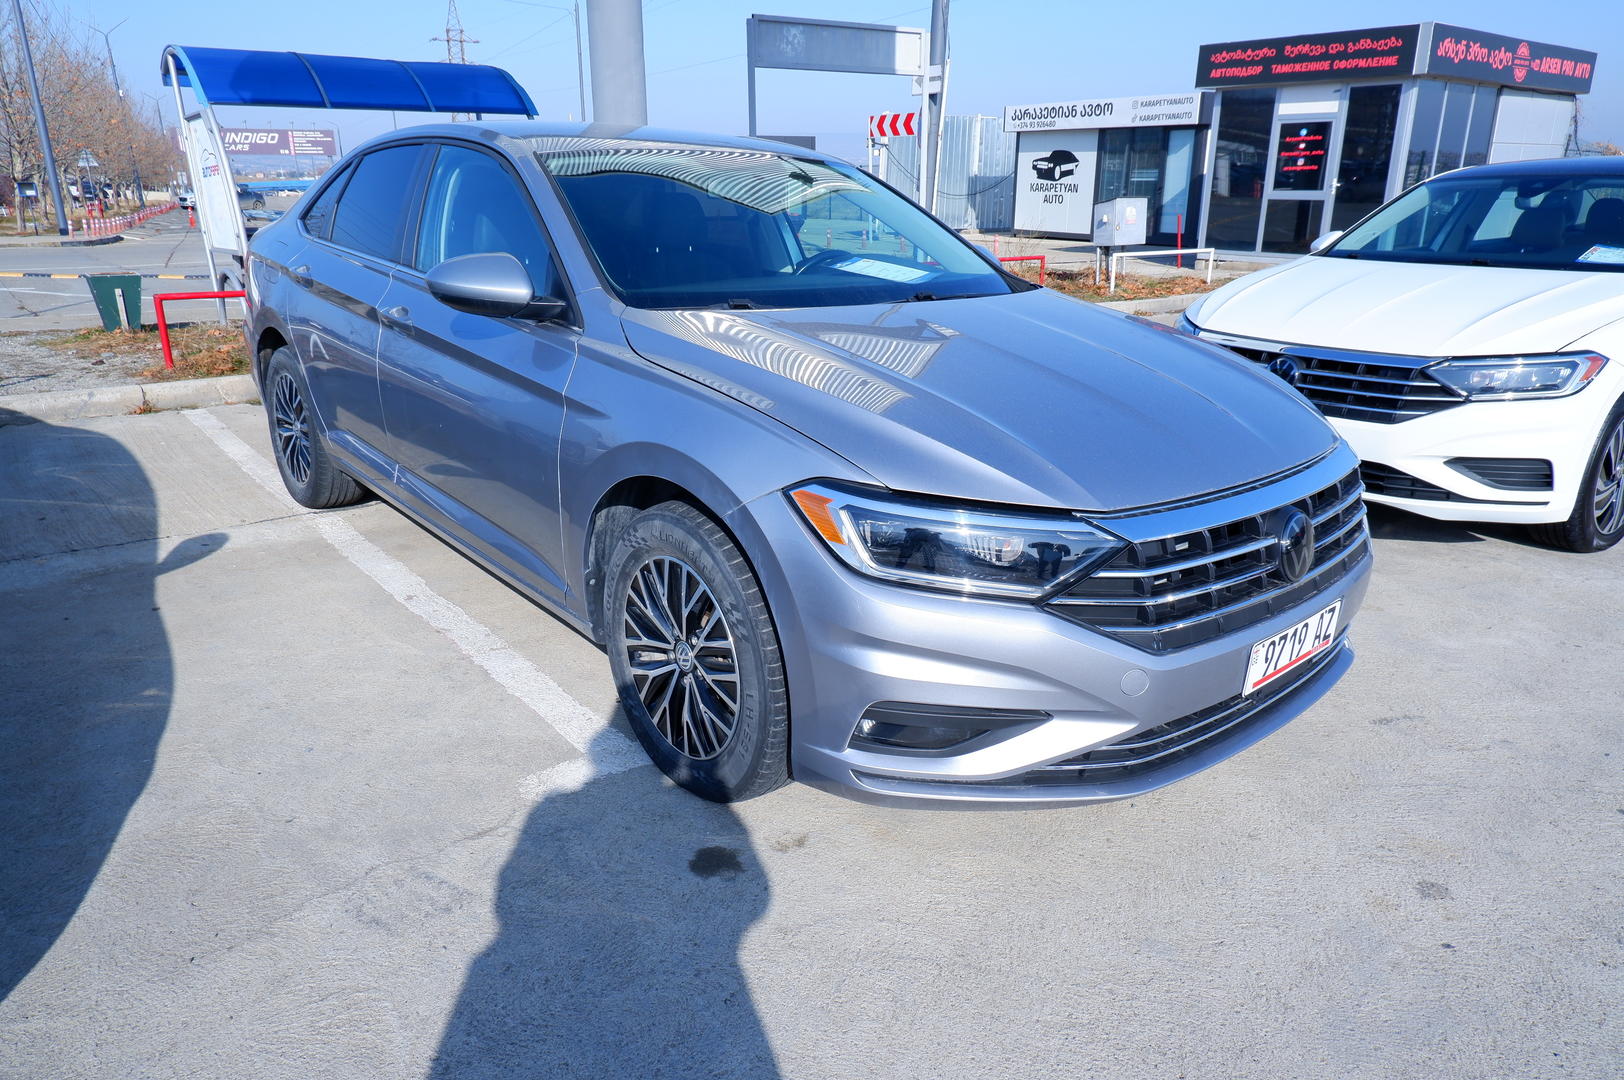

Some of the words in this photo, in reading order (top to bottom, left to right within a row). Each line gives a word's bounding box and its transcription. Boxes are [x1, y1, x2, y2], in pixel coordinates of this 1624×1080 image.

[1329, 43, 1345, 54] და
[1210, 65, 1263, 79] АВТОПОДБОР
[1271, 60, 1331, 75] ТАМОЖЕННОЕ
[1333, 55, 1400, 70] ОФОРМЛЕНИЕ
[1540, 57, 1562, 74] ARSEN
[1140, 96, 1194, 109] KARAPETYANAUTO
[1138, 111, 1192, 122] KARAPETYANAUTO
[225, 132, 279, 144] INDIGO
[1029, 182, 1079, 194] KARAPETYAN
[1043, 194, 1064, 205] AUTO
[1264, 622, 1309, 677] 9719
[1313, 605, 1337, 648] AZ
